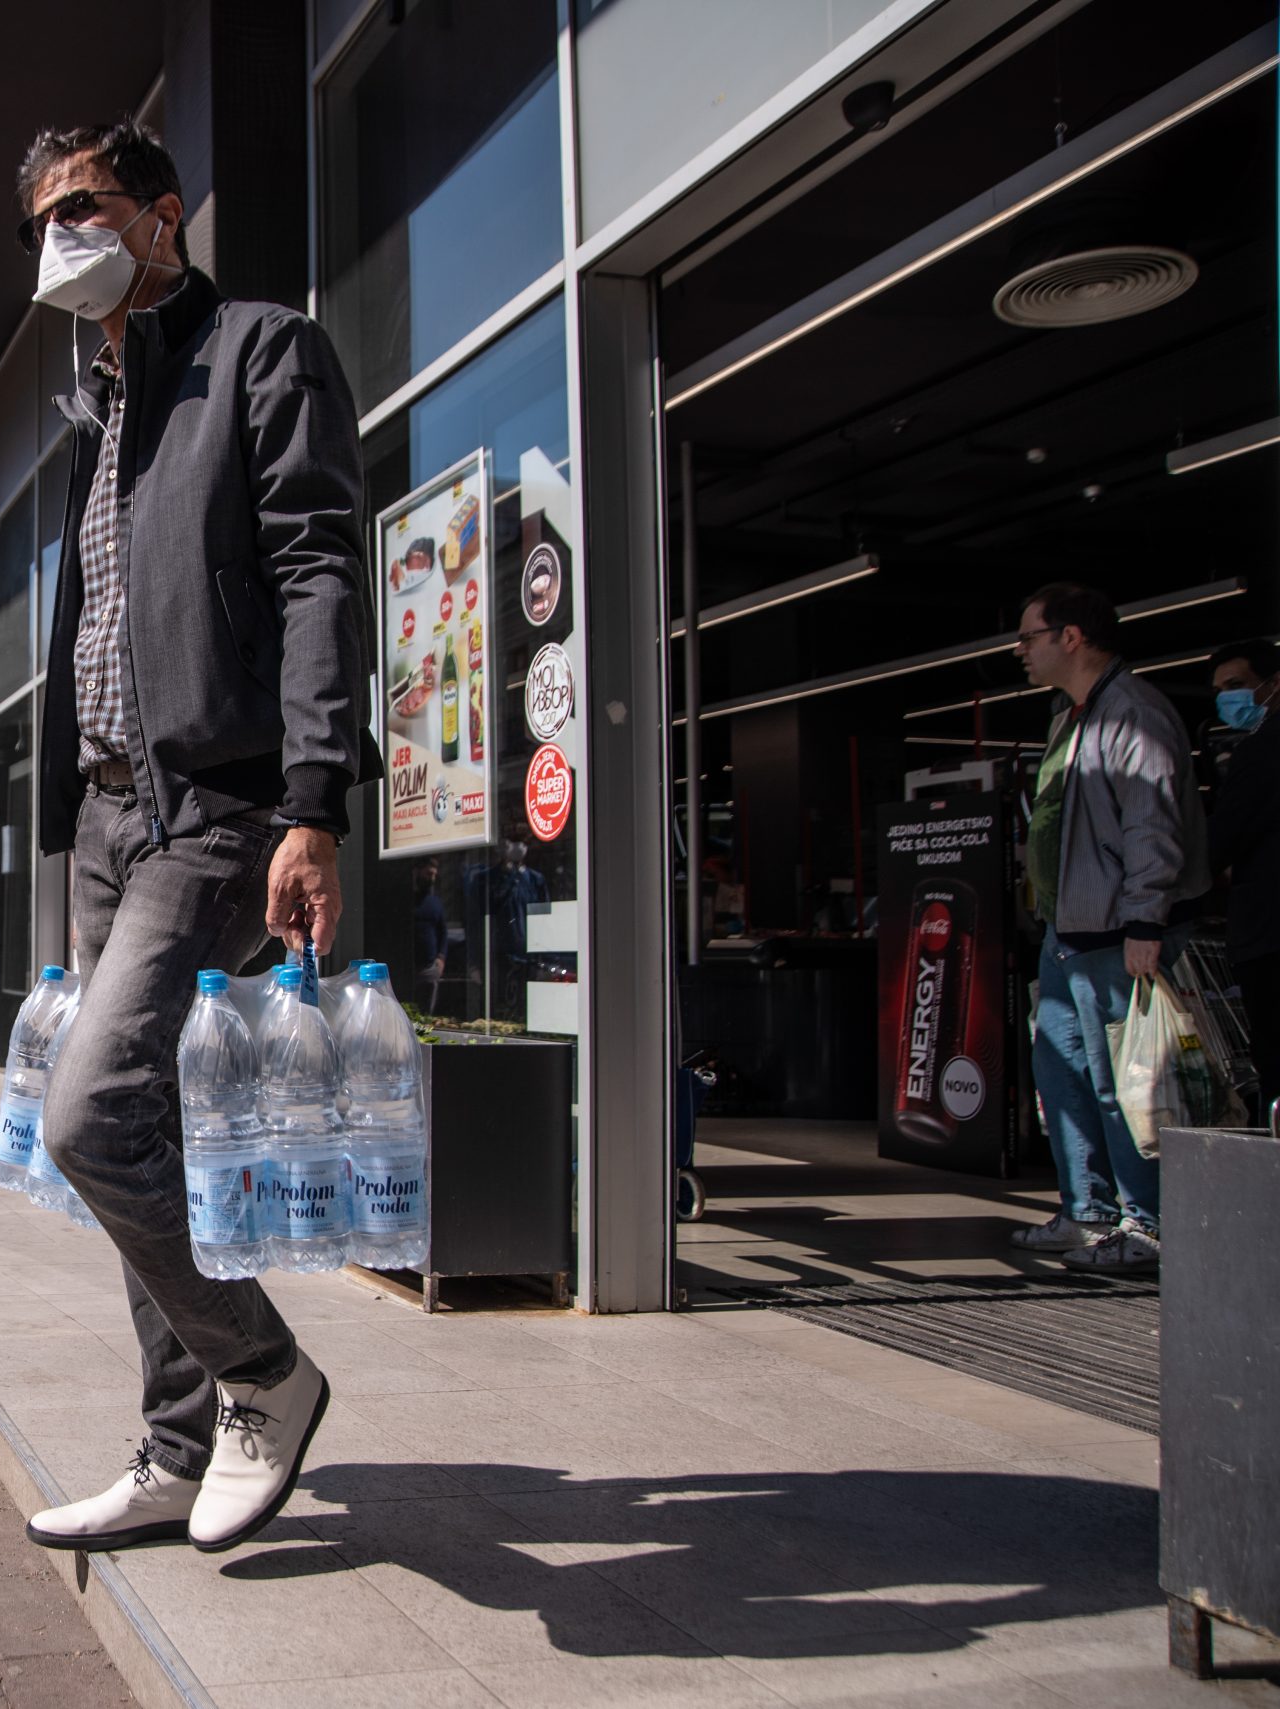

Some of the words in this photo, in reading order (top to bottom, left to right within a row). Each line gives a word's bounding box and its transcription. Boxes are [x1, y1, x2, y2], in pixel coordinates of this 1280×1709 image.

[532, 685, 569, 713] ИЗБОР
[392, 745, 411, 768] JER
[392, 762, 428, 800] VOLIM
[537, 776, 564, 794] SUPER
[463, 795, 484, 810] MAXI
[537, 791, 565, 806] MARKET
[887, 823, 924, 837] JEDINO
[925, 816, 993, 834] ENERGETSKO
[915, 838, 929, 850] SA
[930, 832, 989, 849] COCA-COLA
[917, 851, 961, 865] UKUSOM
[906, 957, 937, 1099] ENERGY
[945, 1080, 980, 1094] NOVO
[272, 1179, 335, 1202] Prolom
[355, 1174, 419, 1197] Prolom
[286, 1202, 326, 1218] voda
[371, 1198, 410, 1214] voda
